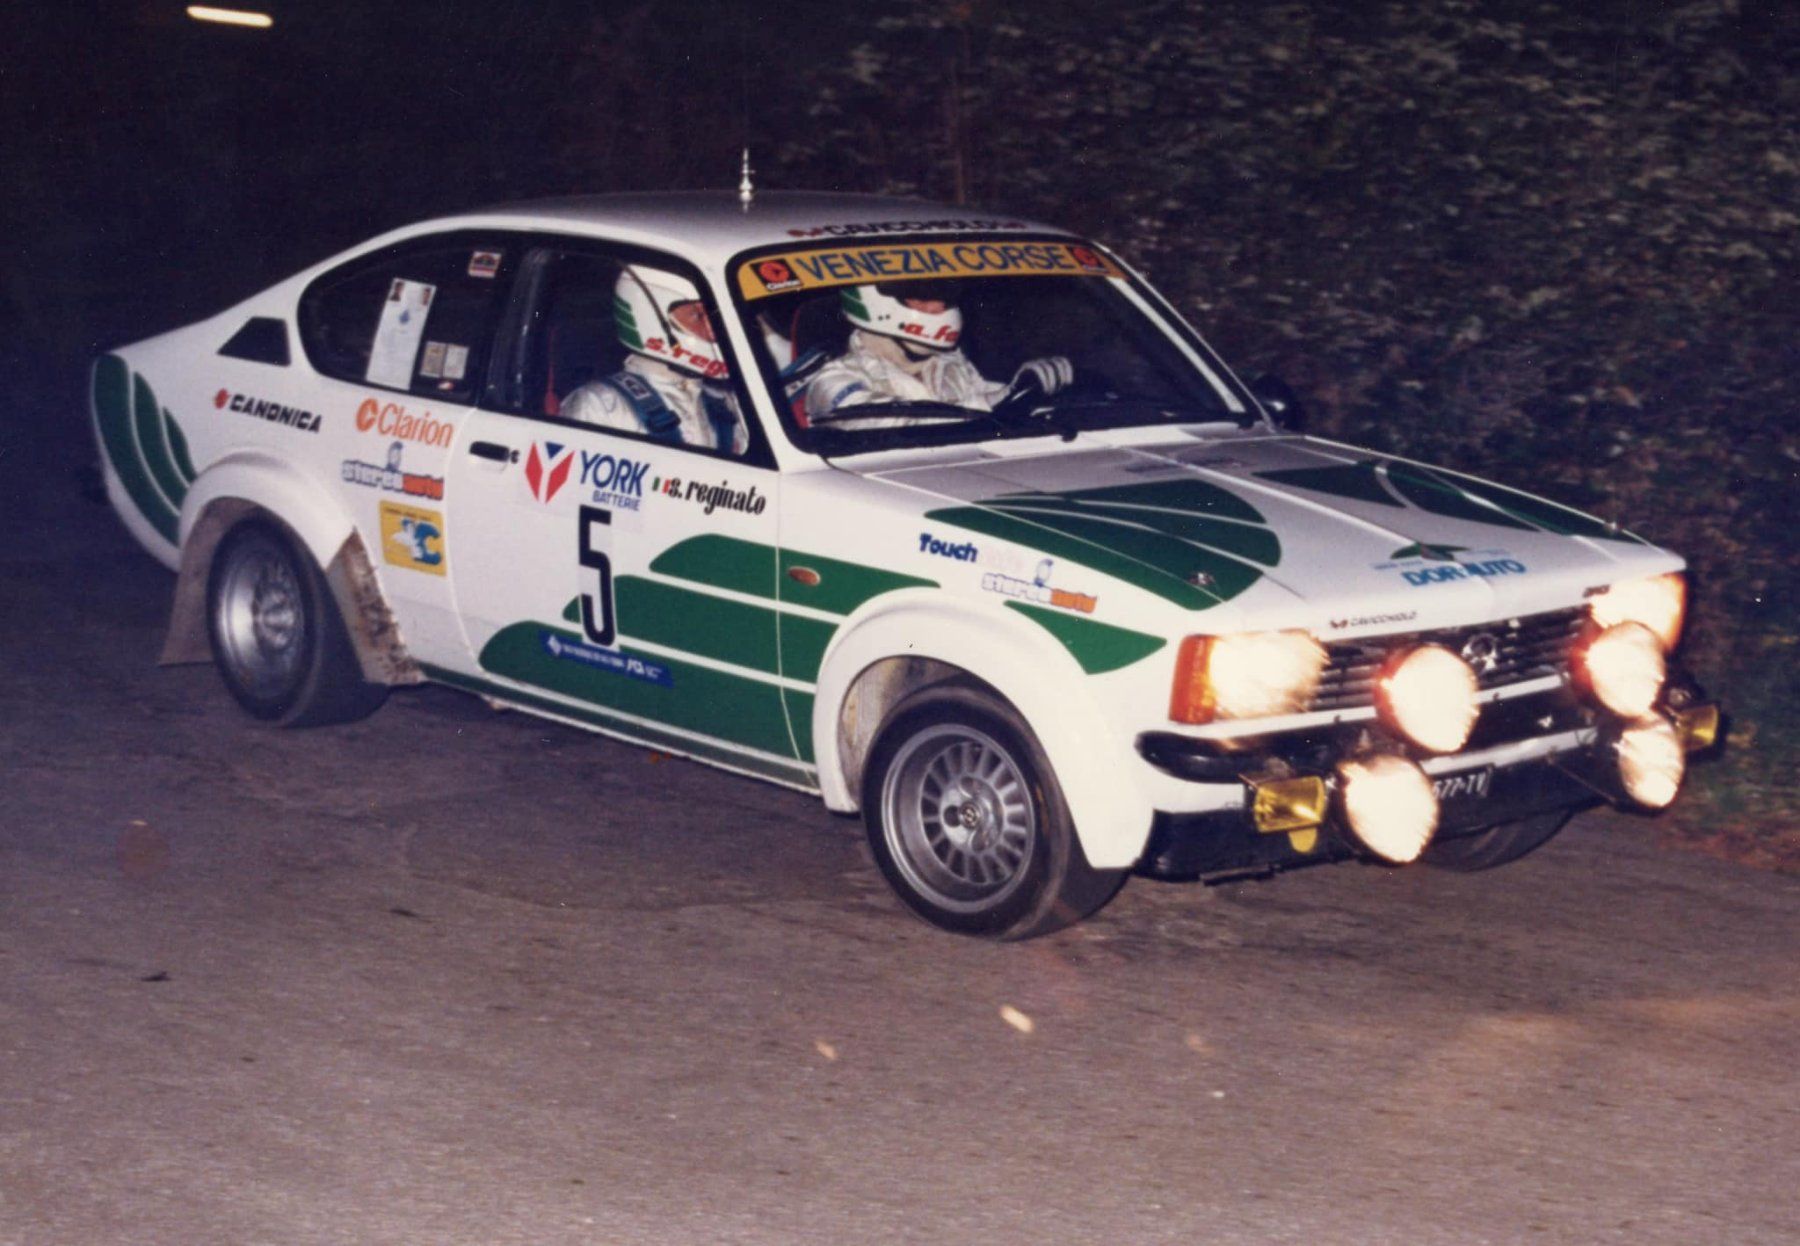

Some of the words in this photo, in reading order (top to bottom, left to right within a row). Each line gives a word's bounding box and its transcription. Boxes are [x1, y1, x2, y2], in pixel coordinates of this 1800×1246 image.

[795, 249, 957, 280] VENEZIA
[952, 245, 1075, 271] CORSE
[229, 394, 323, 433] CANONICA
[378, 403, 453, 448] Clarion
[580, 449, 650, 497] YORK
[592, 490, 641, 512] BATTERIE
[919, 532, 979, 563] Touch
[579, 504, 616, 647] 5
